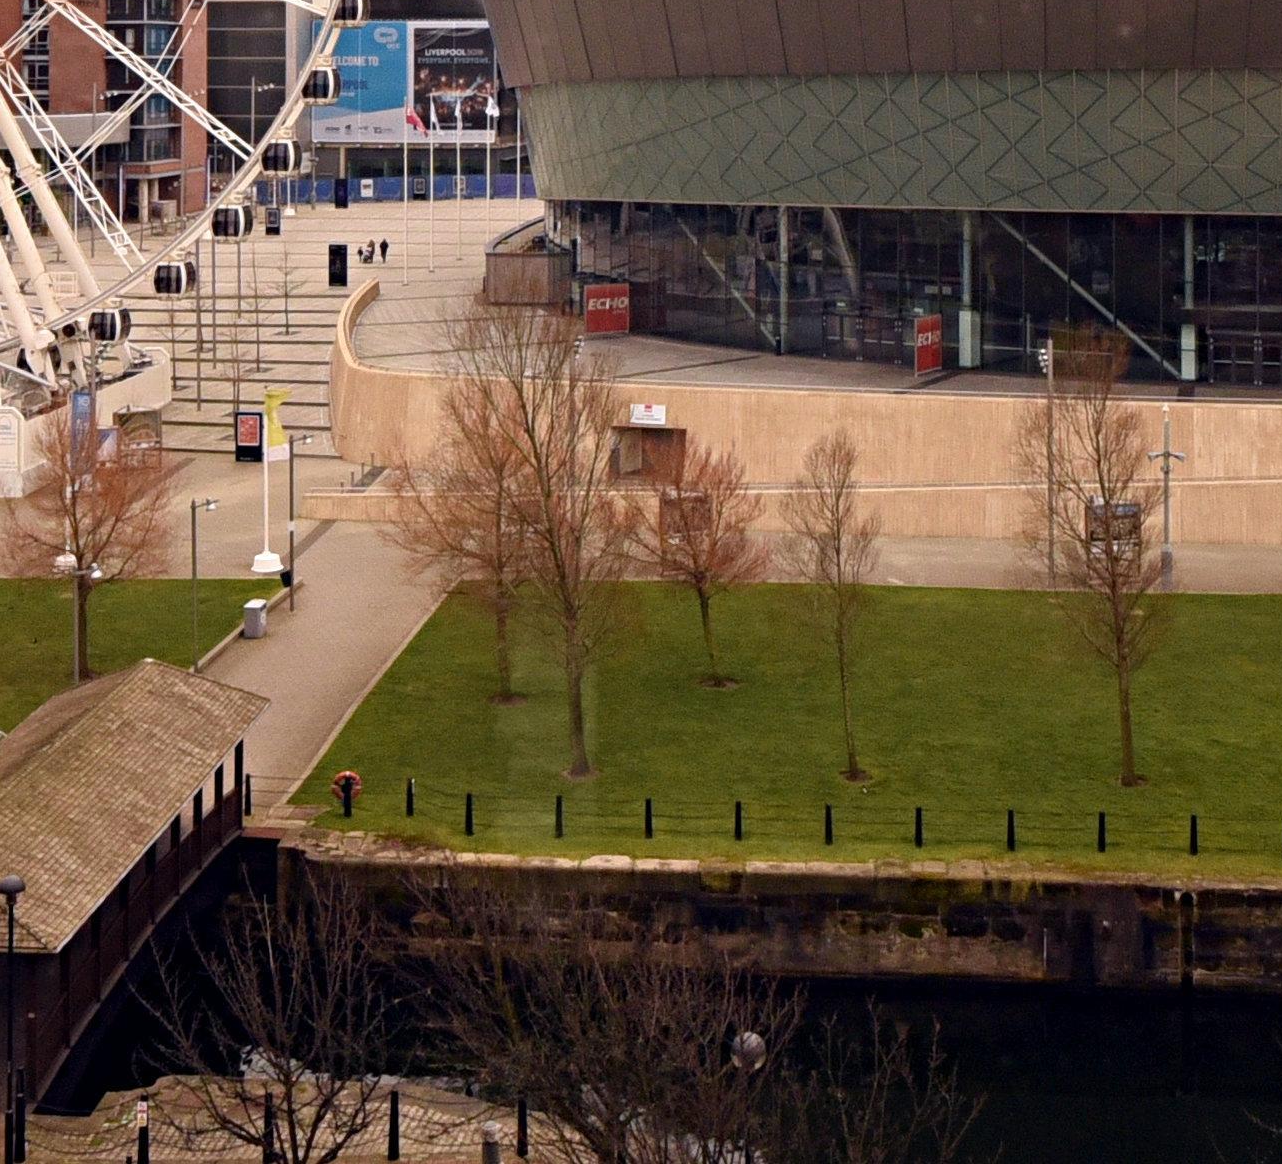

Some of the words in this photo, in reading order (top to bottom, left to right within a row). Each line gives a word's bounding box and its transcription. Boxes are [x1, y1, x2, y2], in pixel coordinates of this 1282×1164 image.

[425, 48, 466, 56] LIVERPOOL
[332, 56, 366, 66] ELCOME
[588, 297, 628, 310] ECHO
[918, 331, 940, 346] ECHO
